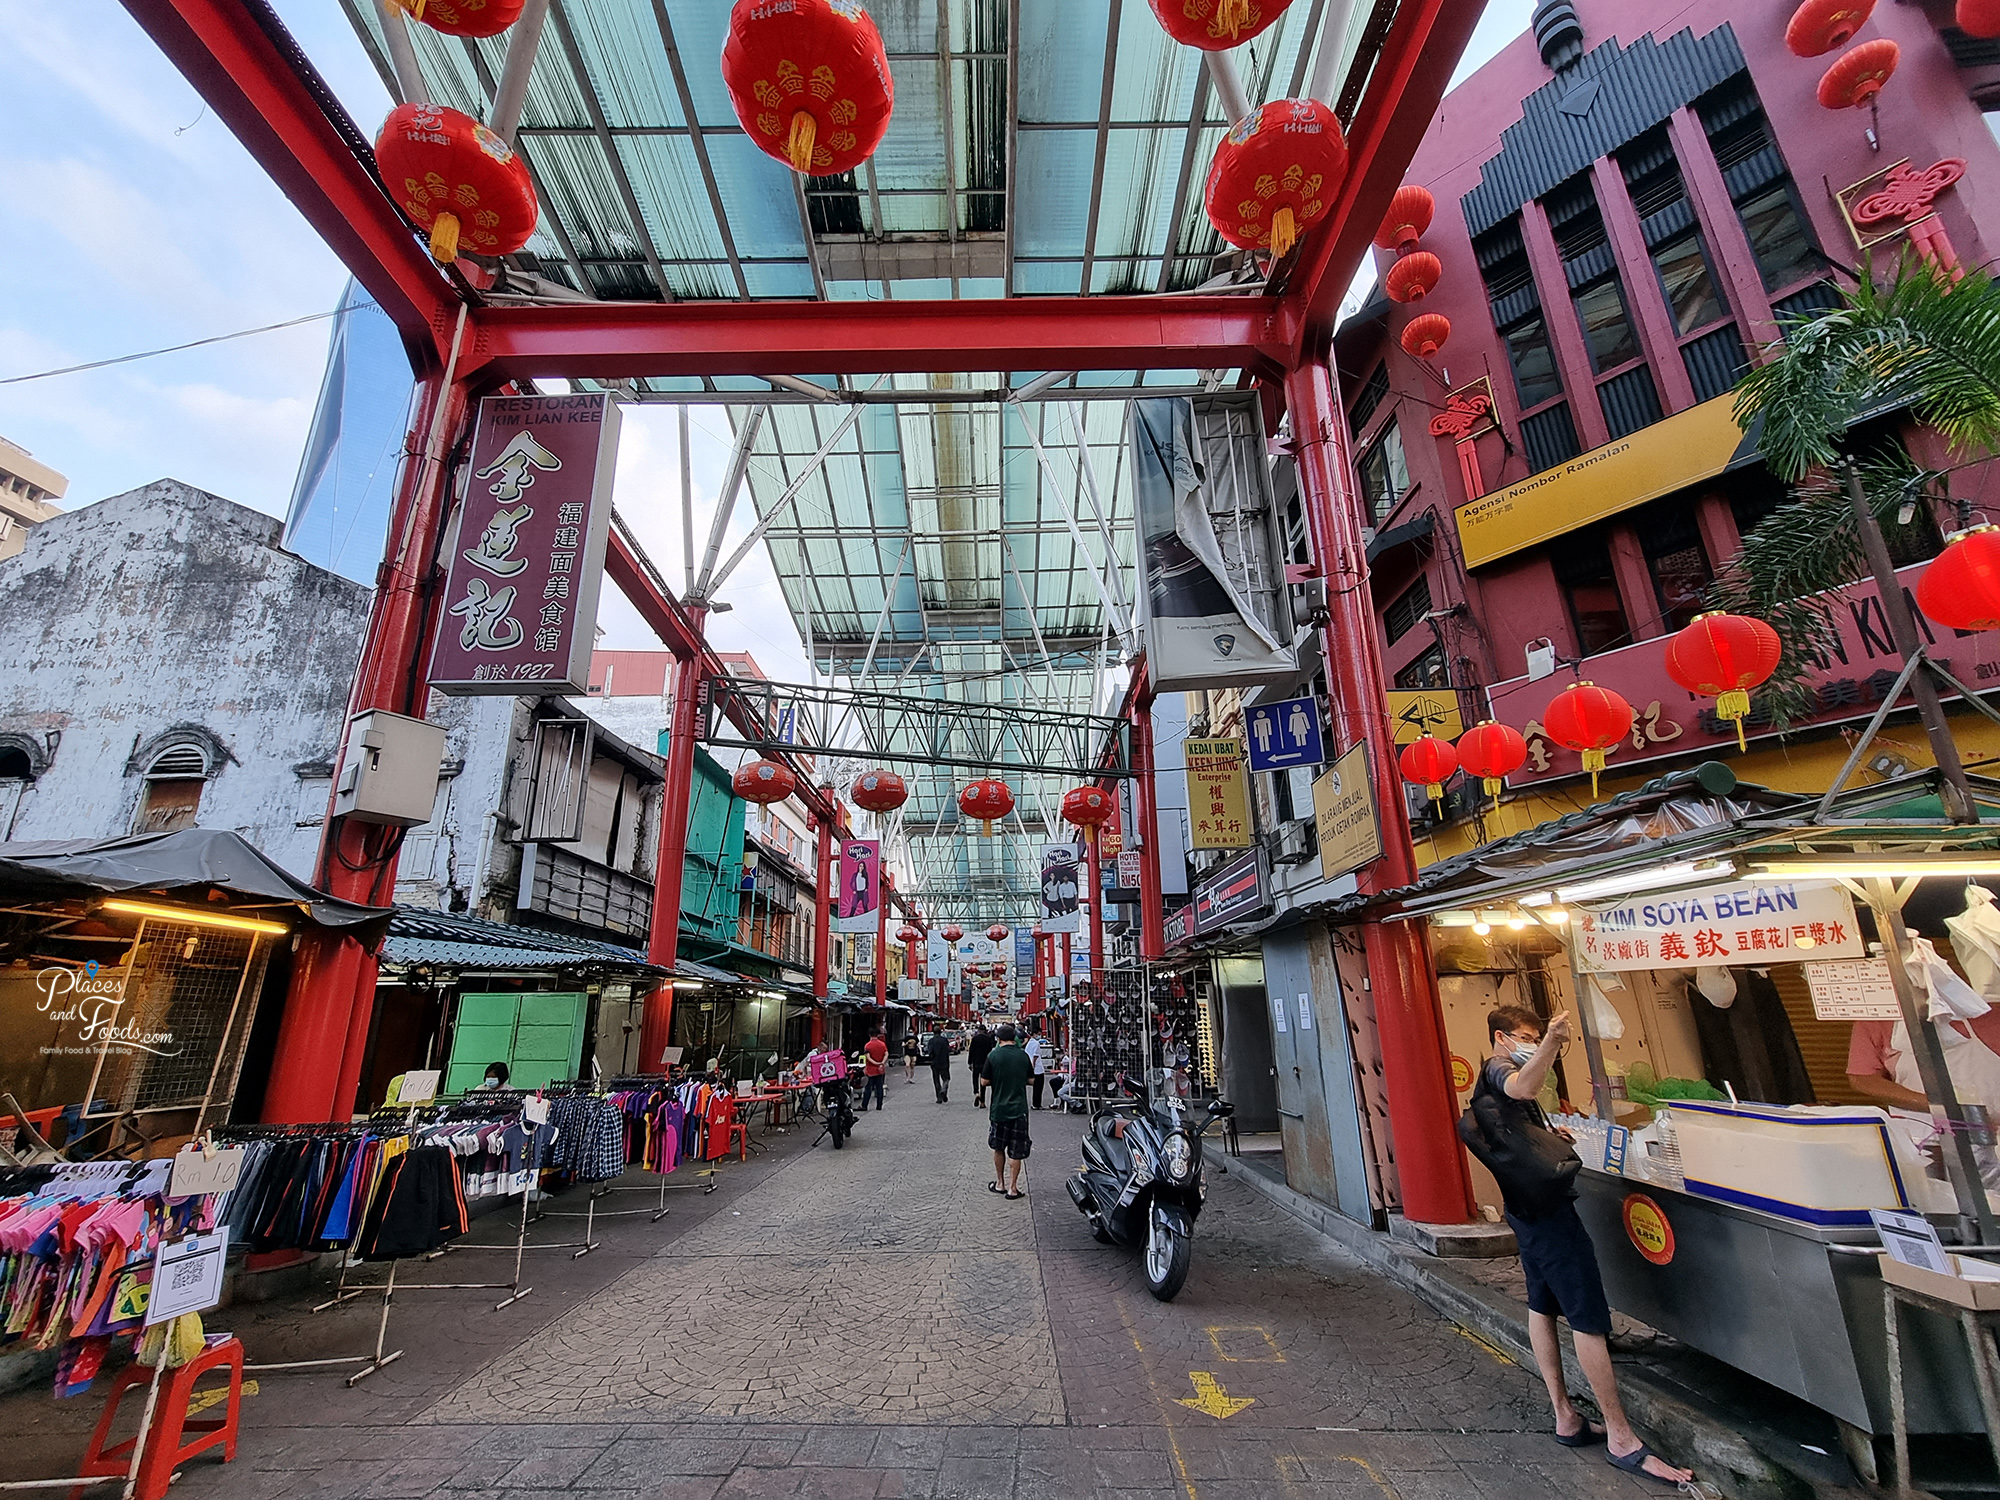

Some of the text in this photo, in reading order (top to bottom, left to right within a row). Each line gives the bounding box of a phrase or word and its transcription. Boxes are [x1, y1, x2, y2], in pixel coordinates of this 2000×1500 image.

[494, 395, 601, 412] RESTORAN
[491, 410, 600, 426] KIM LIAN KEE
[1463, 442, 1631, 518] Agensi Nombor Ramalan
[534, 502, 584, 651] 福建面美食馆
[510, 662, 555, 680] 1927
[1188, 742, 1234, 755] KEDAI UBAT
[1187, 756, 1239, 772] KEEN HING
[1197, 773, 1231, 782] Enterprise
[1110, 835, 1122, 843] 60
[1102, 845, 1121, 855] Night
[1119, 853, 1140, 861] HOTEL
[1600, 883, 1799, 933] KIM SOYA BEAN
[417, 1078, 433, 1093] 10
[212, 1161, 236, 1183] 10
